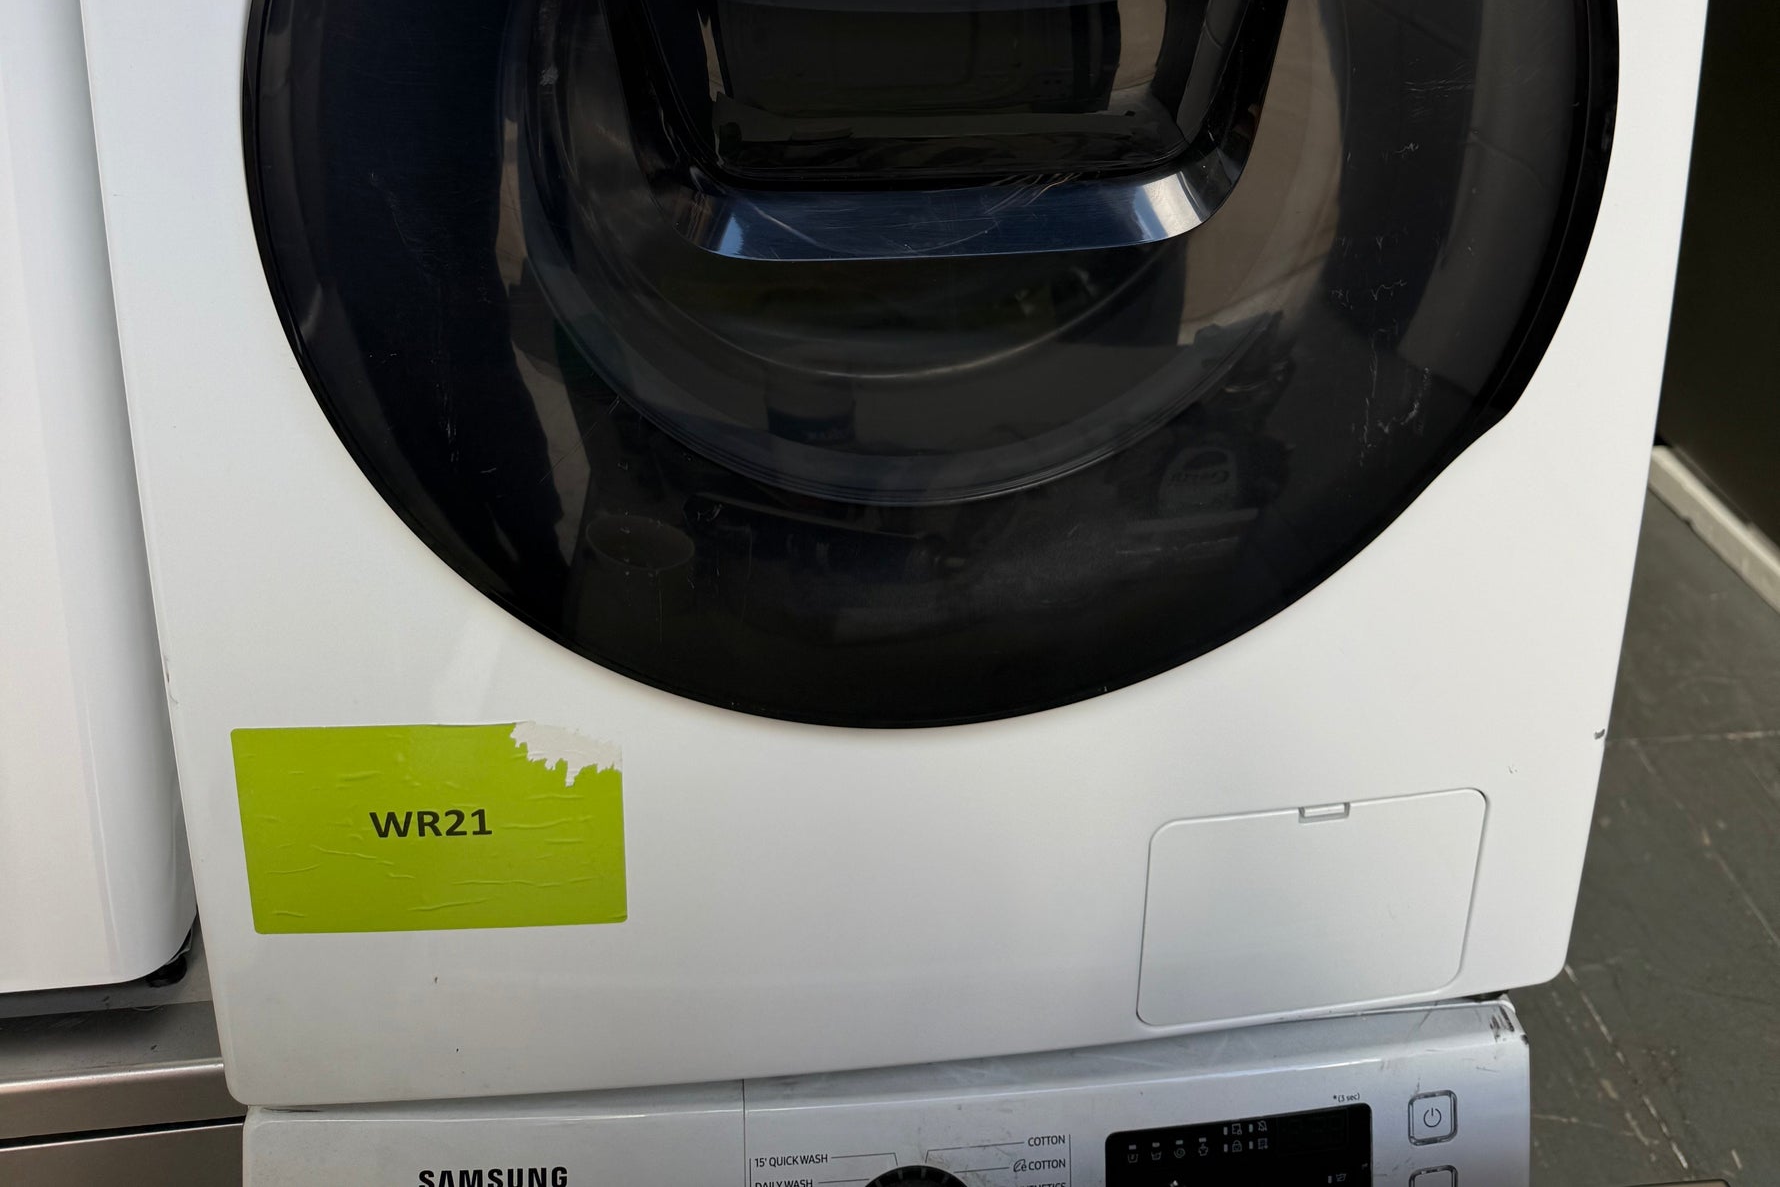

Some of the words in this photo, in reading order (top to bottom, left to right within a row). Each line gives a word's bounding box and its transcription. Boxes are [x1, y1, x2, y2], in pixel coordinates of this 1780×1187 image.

[368, 808, 493, 838] WR21
[1027, 1135, 1065, 1147] COTTON
[768, 1156, 799, 1168] QUICK
[799, 1153, 828, 1164] WASH
[419, 1167, 567, 1187] SAMSUNG
